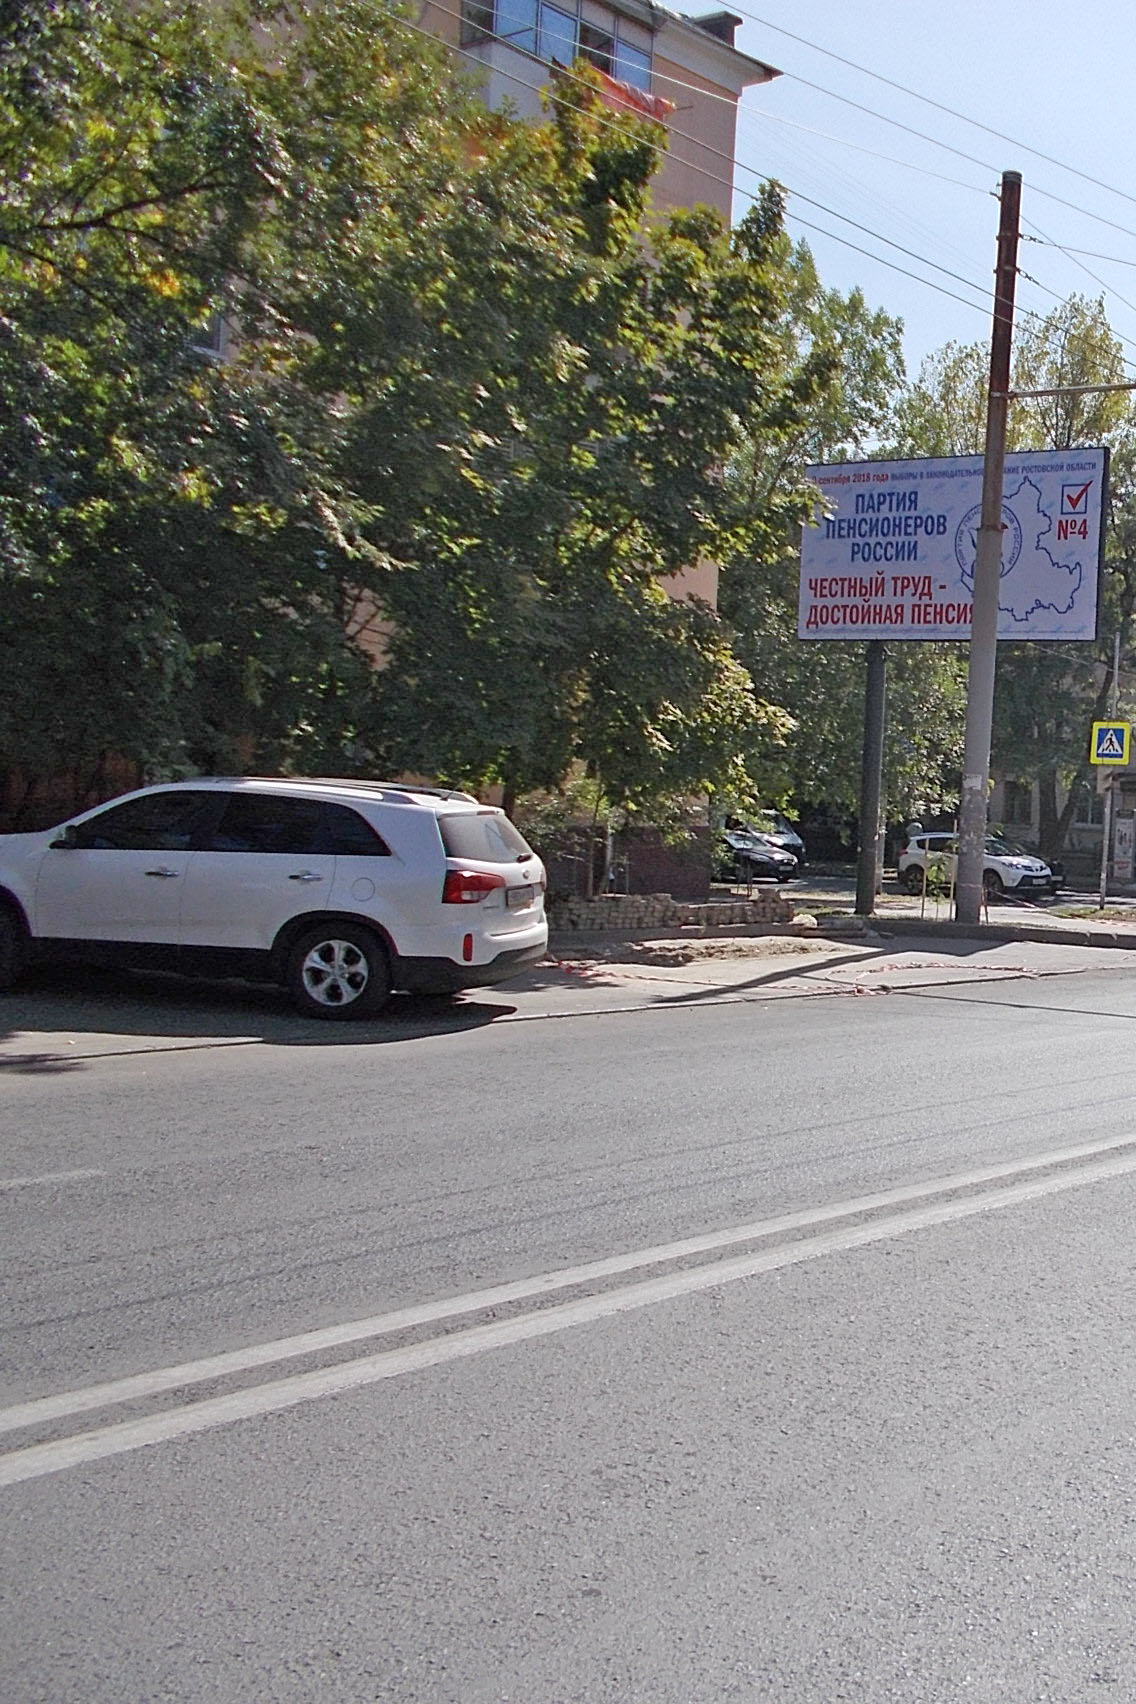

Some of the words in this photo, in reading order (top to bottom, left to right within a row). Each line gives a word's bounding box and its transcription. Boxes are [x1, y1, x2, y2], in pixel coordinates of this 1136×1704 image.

[852, 472, 871, 483] 2018
[872, 472, 890, 484] года
[1021, 464, 1064, 474] РОСТОВСКОЙ
[1066, 462, 1097, 471] ОБЛАСТИ
[855, 491, 918, 514] ПАРТИЯ
[826, 514, 947, 539] ПЕНСИОНЕРОВ
[1058, 518, 1088, 540] №4
[851, 540, 918, 562] РОССИИ
[808, 570, 885, 598] ЧЕСТНЫЙ
[891, 575, 932, 601] ТРУД
[806, 599, 904, 629] ДОСТОЙНАЯ
[911, 602, 974, 625] ПЕНСИ
